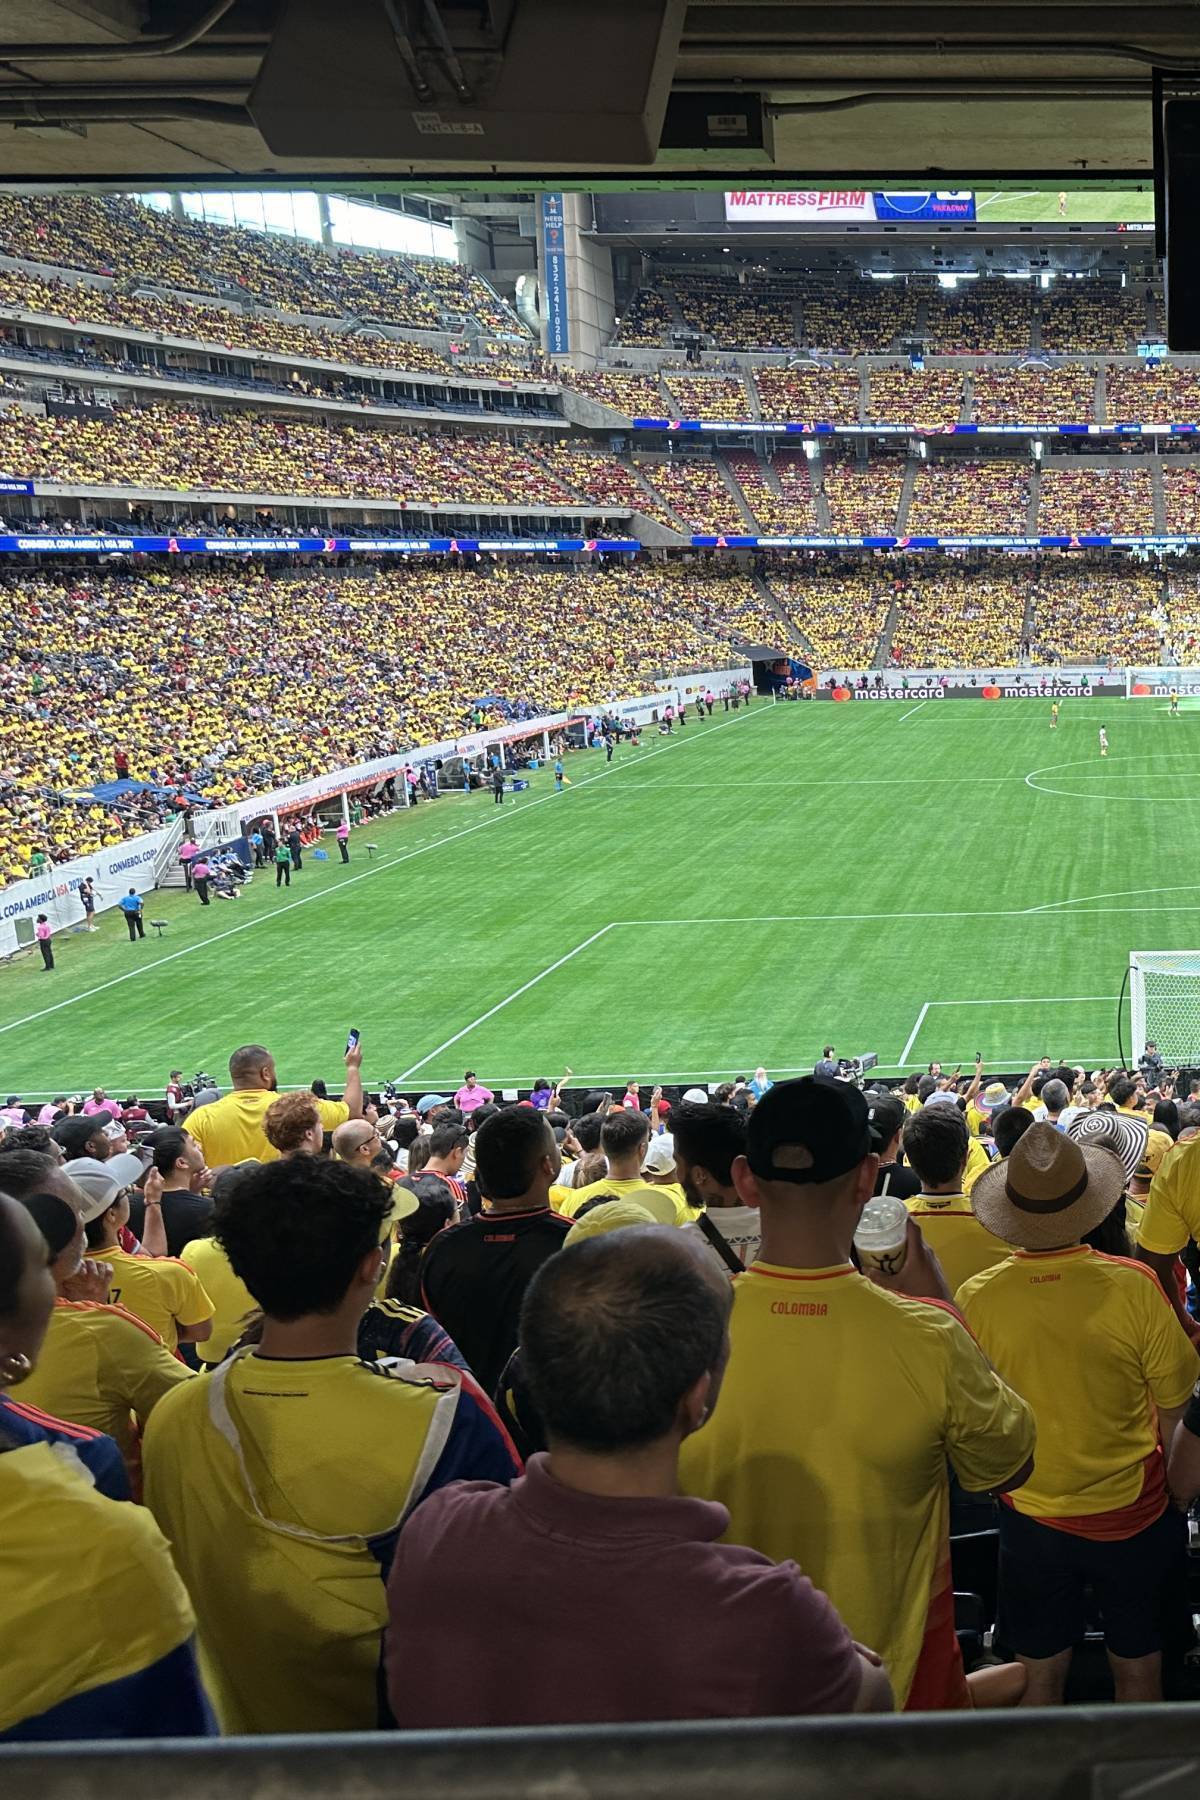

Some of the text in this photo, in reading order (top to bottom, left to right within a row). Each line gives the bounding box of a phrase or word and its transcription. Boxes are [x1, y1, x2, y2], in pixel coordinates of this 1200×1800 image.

[854, 686, 945, 700] mastercard
[1005, 684, 1093, 697] mastercard
[109, 856, 142, 875] CONMEBOL
[3, 903, 25, 918] COPA
[25, 889, 57, 909] AMERICA
[56, 884, 69, 897] USA
[1029, 1273, 1062, 1285] COLOMBIA
[770, 1302, 828, 1316] COLOMBIA
